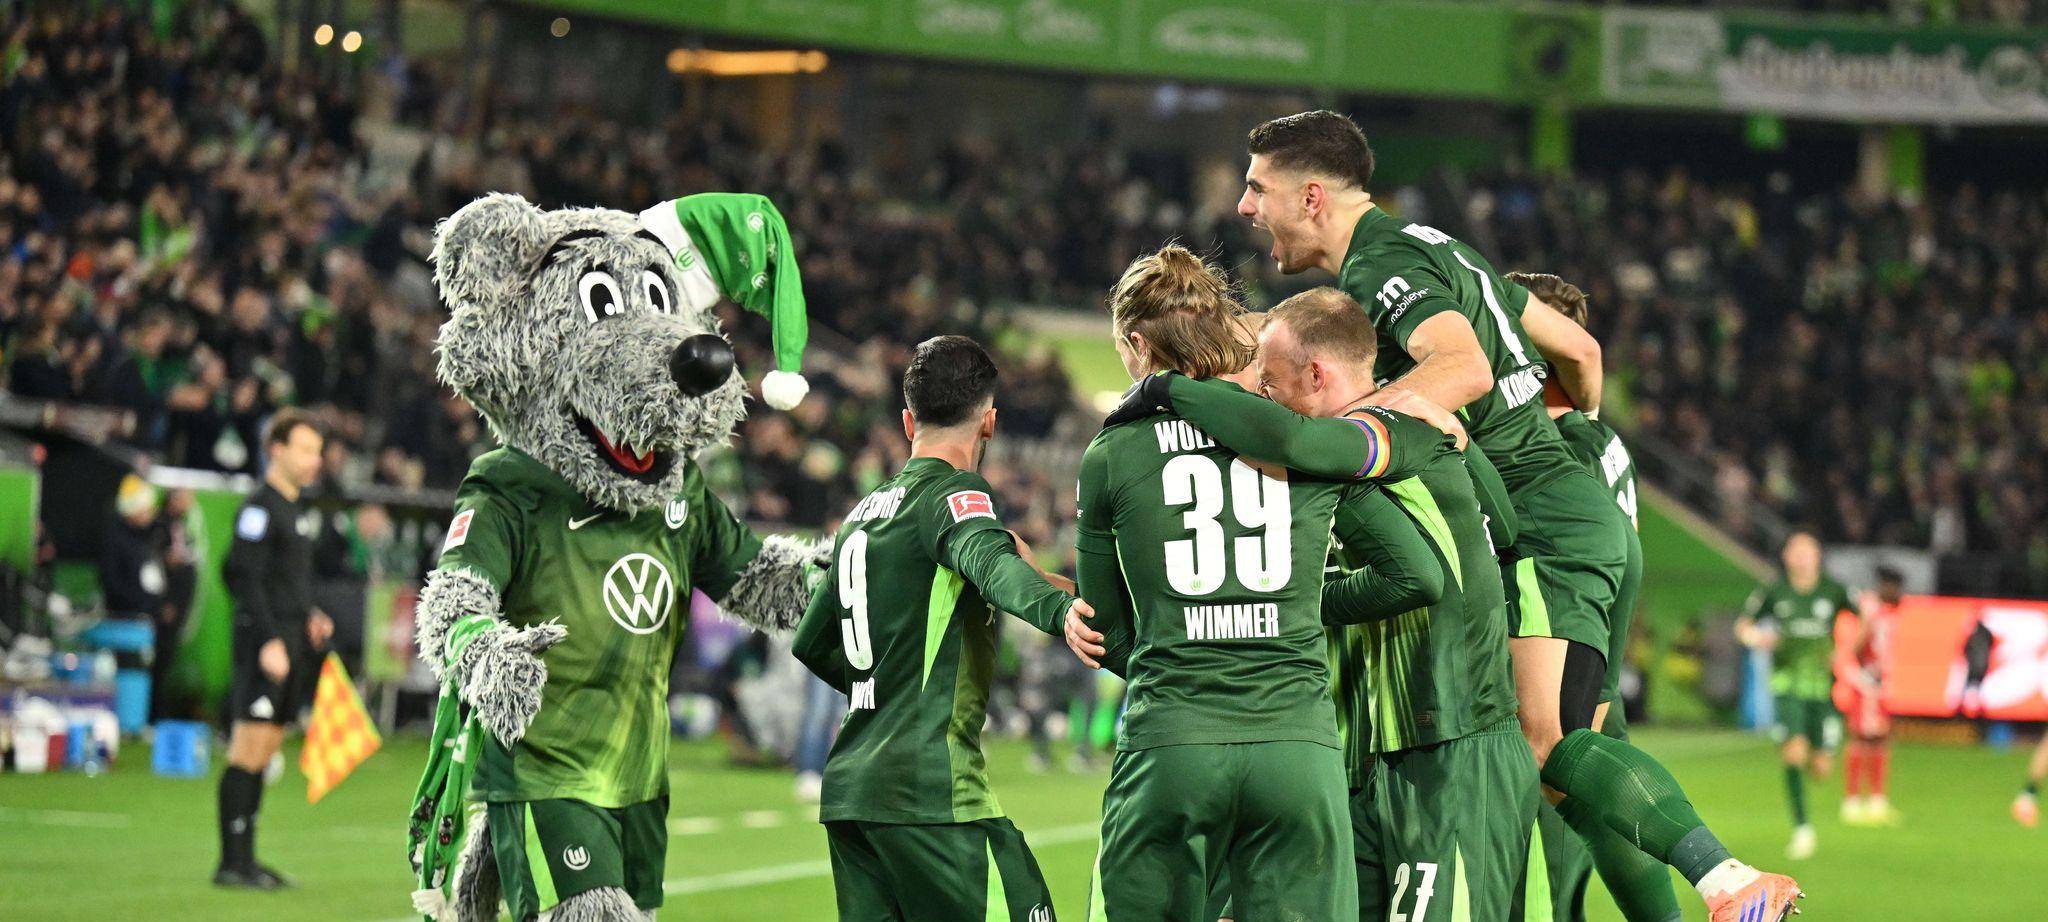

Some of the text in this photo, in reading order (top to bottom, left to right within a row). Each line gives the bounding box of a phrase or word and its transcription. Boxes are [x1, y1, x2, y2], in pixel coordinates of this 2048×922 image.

[1162, 454, 1292, 596] 39
[839, 529, 874, 670] 9
[1183, 602, 1280, 640] WIMMER
[1389, 862, 1438, 922] 27
